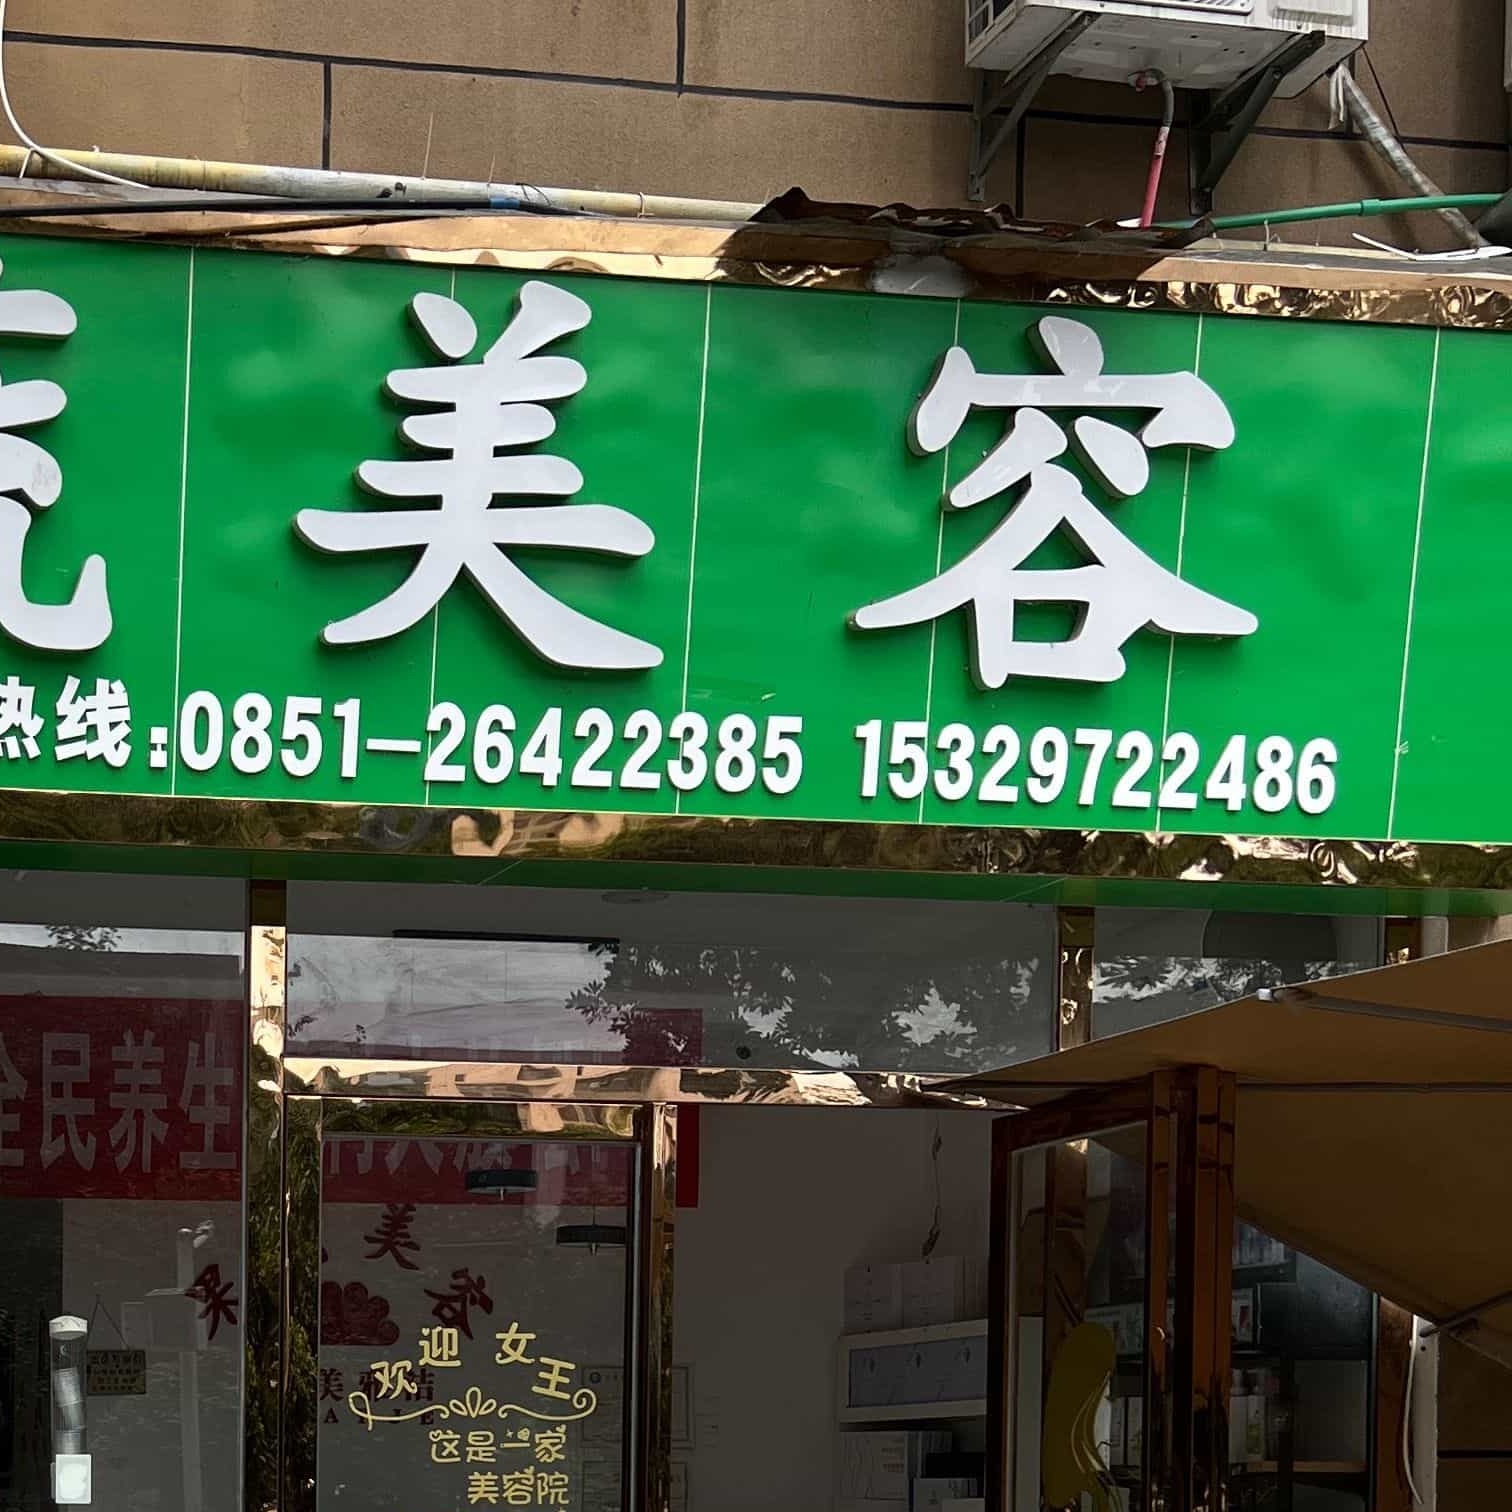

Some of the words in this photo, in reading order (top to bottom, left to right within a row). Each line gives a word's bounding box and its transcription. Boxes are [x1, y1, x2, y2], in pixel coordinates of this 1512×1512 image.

[853, 717, 1338, 816] 15329722486
[429, 1425, 567, 1463] 这是一家
[467, 1466, 569, 1505] 美容院
